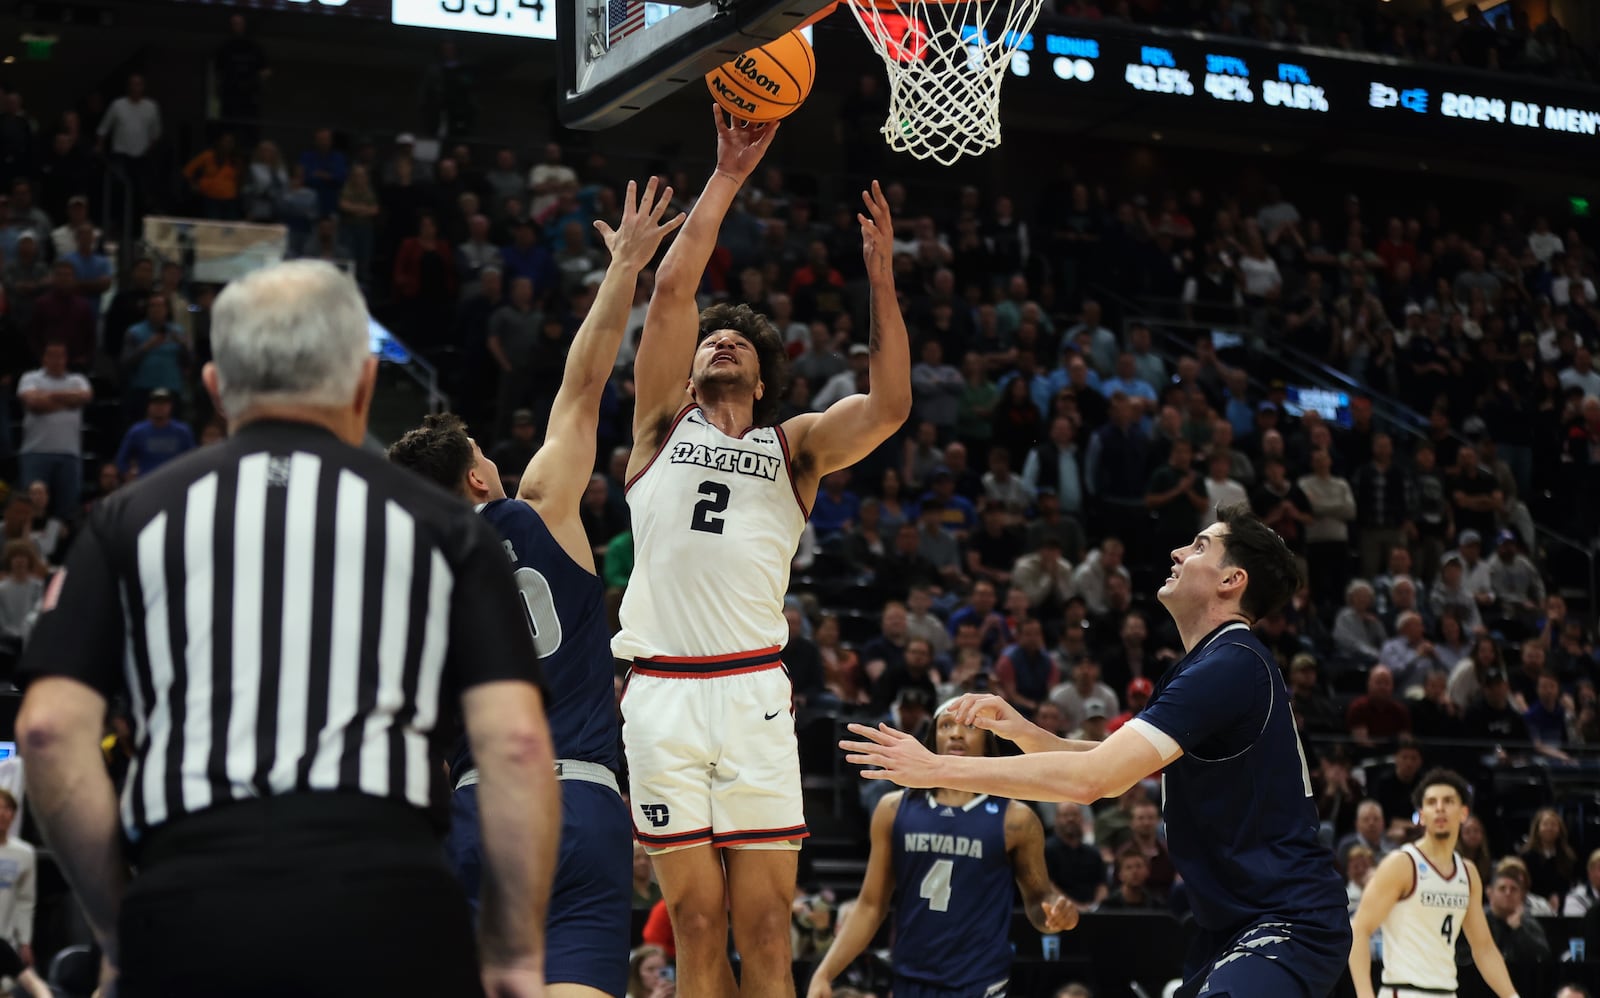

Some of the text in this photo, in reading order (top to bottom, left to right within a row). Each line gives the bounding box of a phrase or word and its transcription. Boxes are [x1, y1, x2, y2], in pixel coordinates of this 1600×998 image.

[712, 75, 757, 114] NCAA
[733, 54, 782, 97] ilson
[1440, 92, 1507, 124] 2024
[1510, 101, 1541, 128] DI
[670, 442, 780, 481] DAYTON
[690, 480, 731, 535] 2
[904, 832, 983, 859] NEVADA
[919, 858, 954, 913] 4
[1441, 913, 1454, 945] 4
